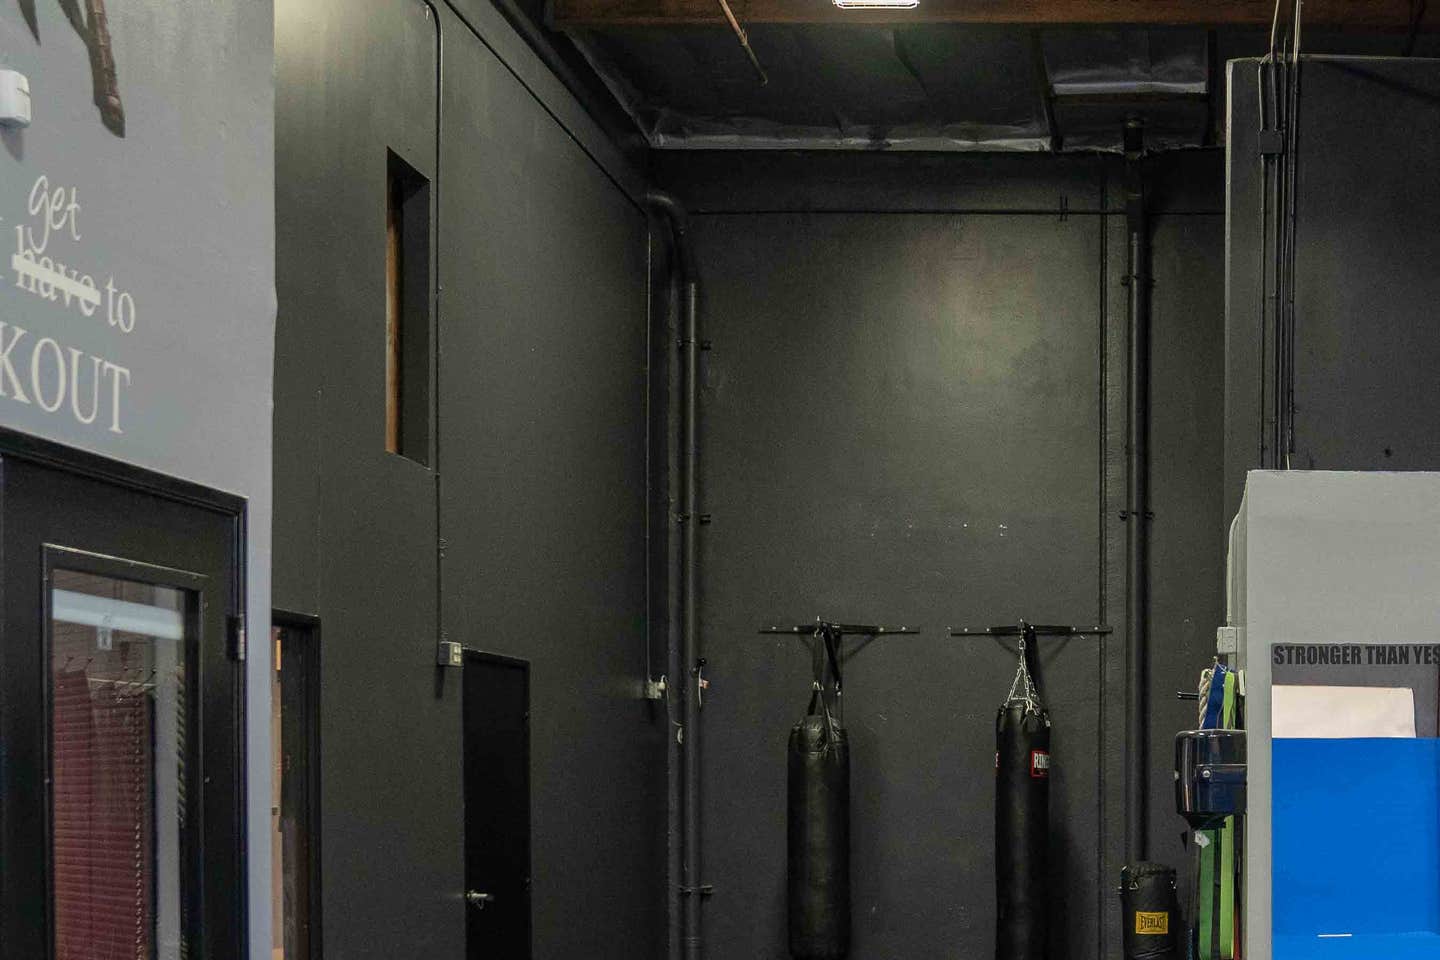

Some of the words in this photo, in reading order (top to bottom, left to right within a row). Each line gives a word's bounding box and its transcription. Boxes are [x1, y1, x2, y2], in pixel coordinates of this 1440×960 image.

[28, 175, 81, 254] get
[106, 275, 136, 333] to
[1273, 645, 1362, 665] STRONGER
[1364, 645, 1410, 665] THAN
[1140, 915, 1166, 930] EVERLAST
